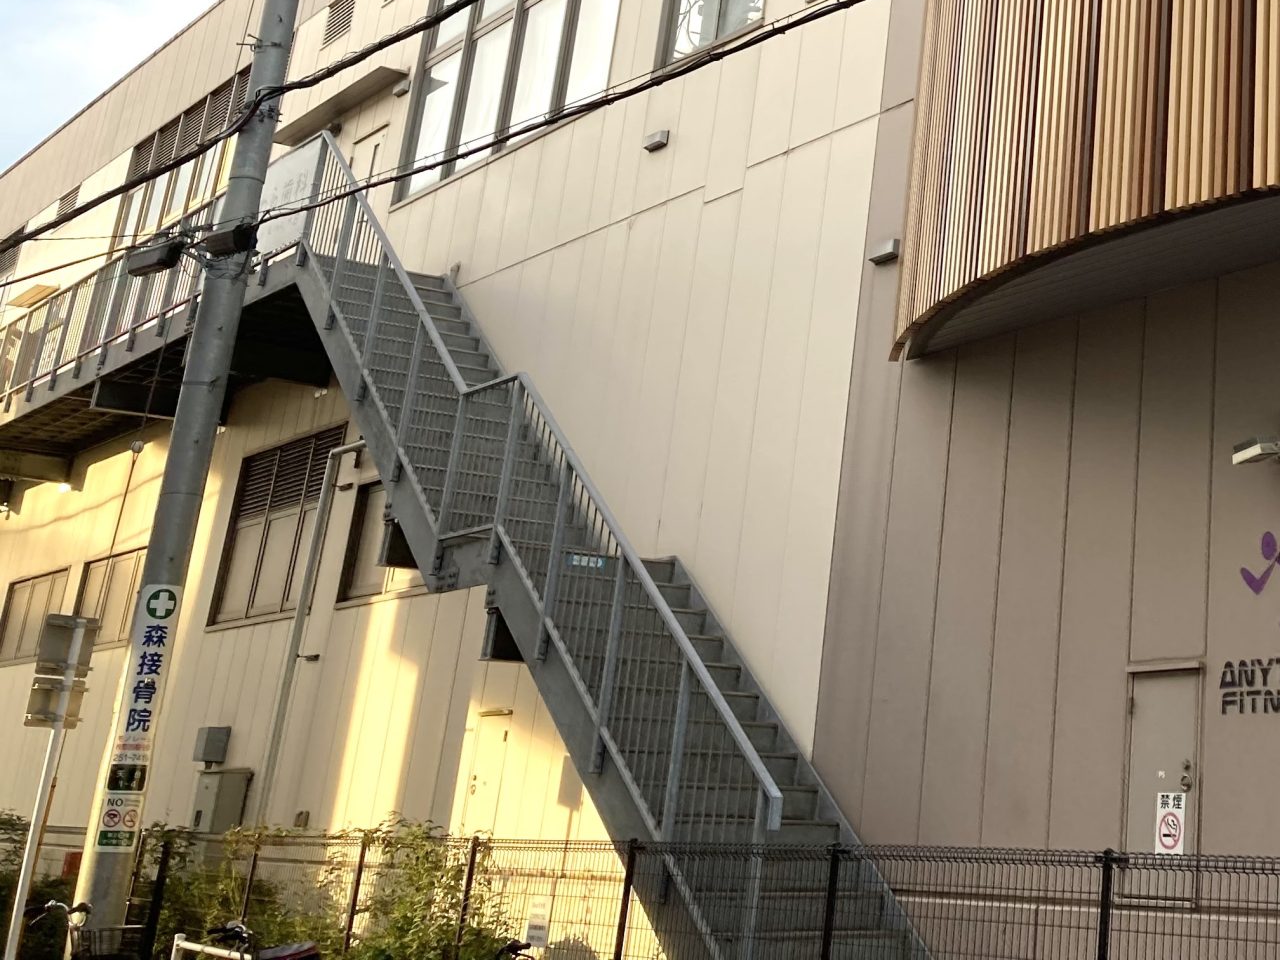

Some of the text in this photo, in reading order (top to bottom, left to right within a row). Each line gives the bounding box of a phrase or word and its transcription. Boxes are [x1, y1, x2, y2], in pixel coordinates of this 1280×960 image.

[125, 624, 168, 733] 森接骨院
[107, 798, 124, 807] NO
[1160, 794, 1183, 810] 禁煙
